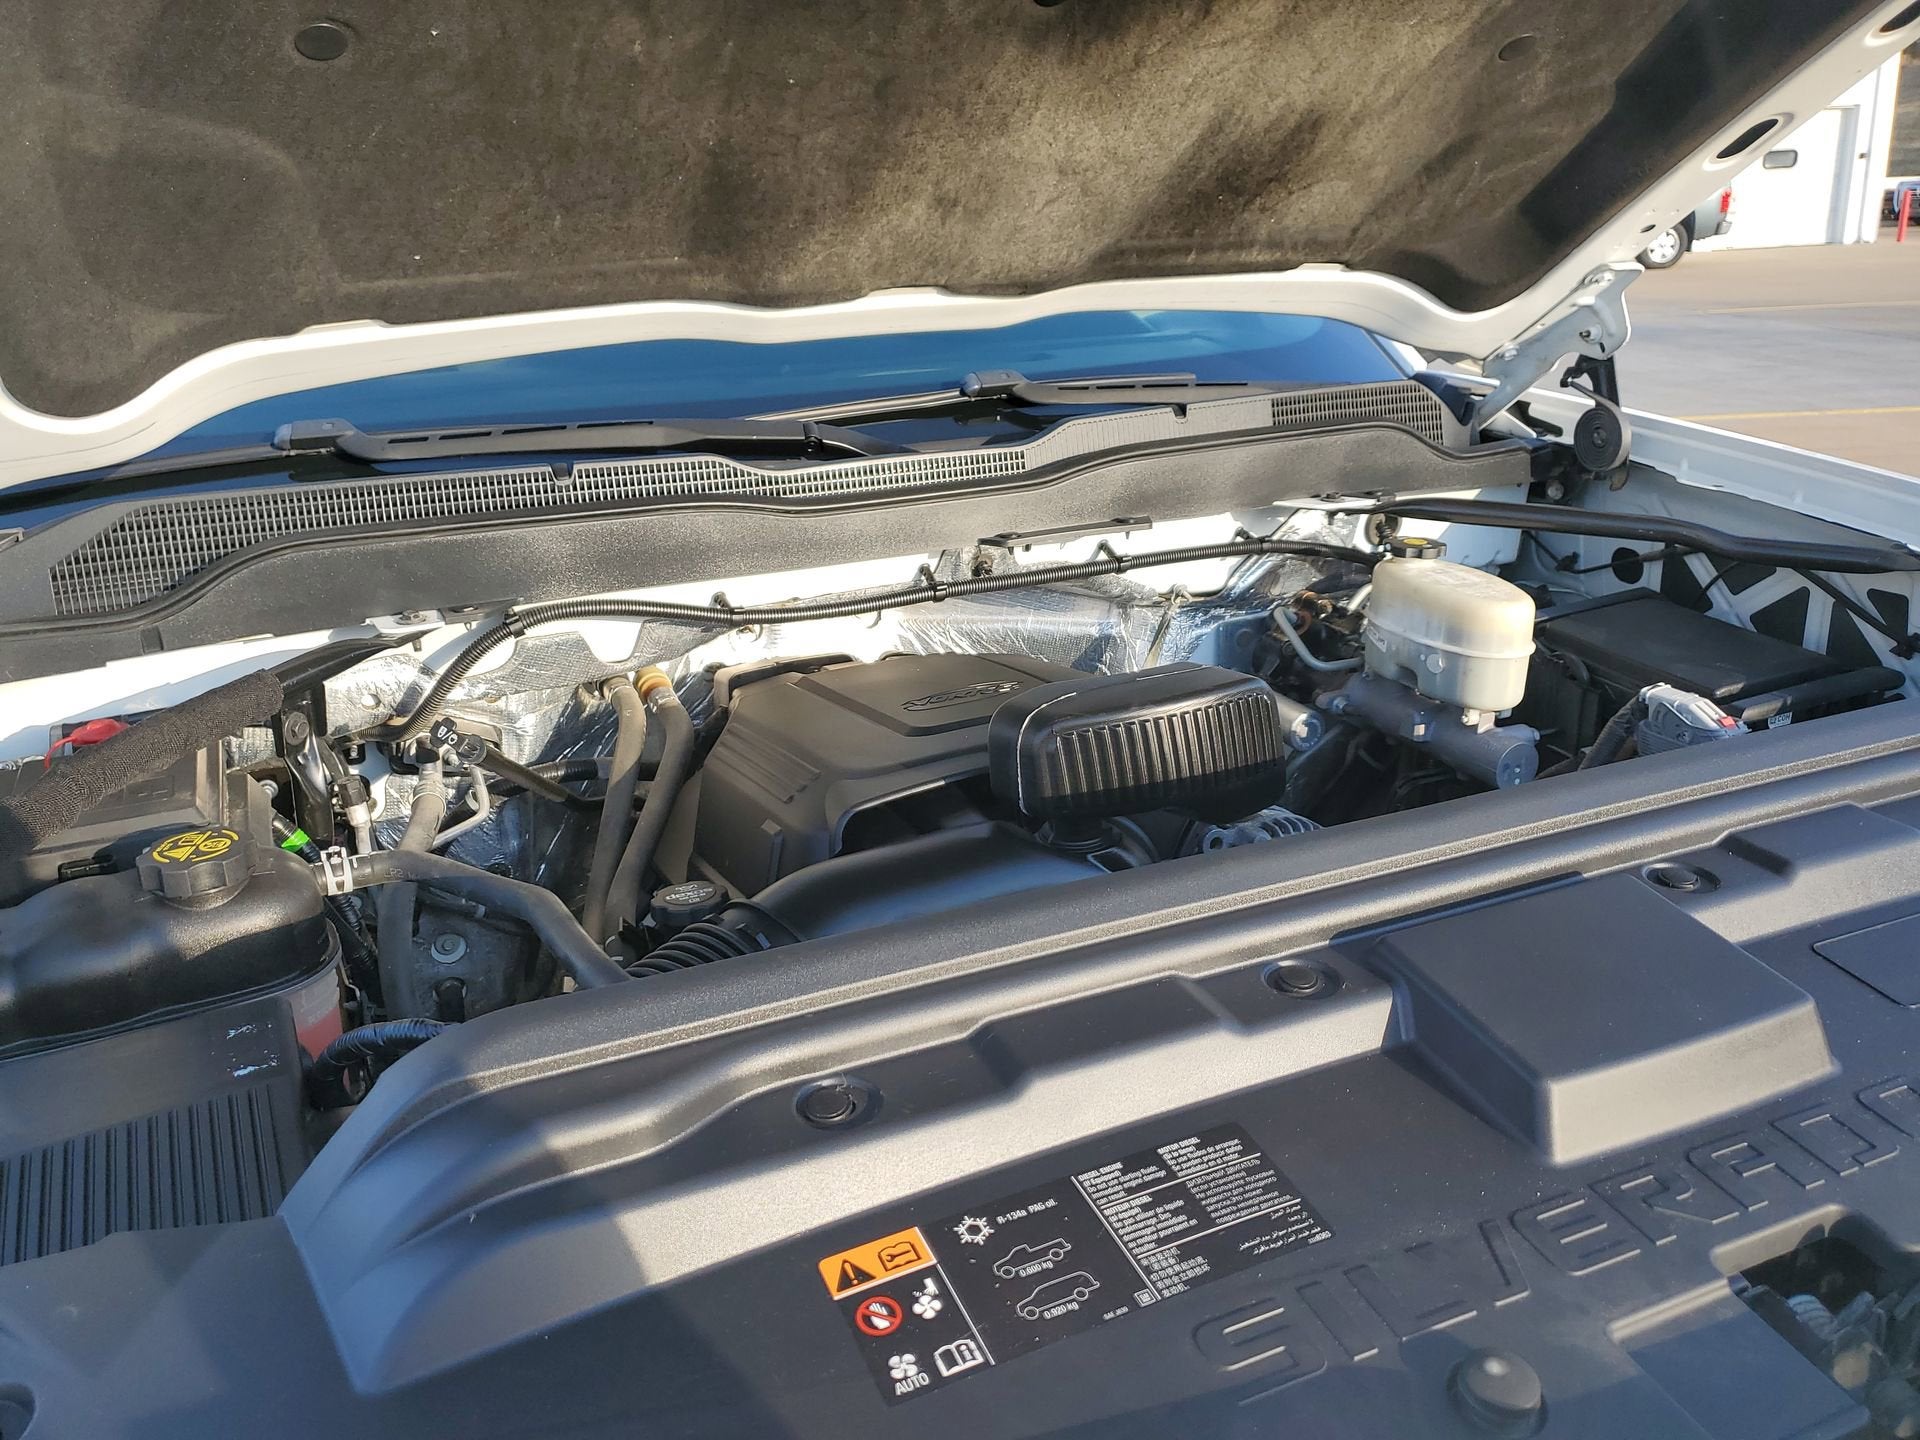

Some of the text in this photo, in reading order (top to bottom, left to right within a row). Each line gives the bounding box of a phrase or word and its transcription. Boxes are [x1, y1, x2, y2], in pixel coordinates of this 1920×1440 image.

[1078, 1170, 1101, 1181] DIESEL
[1118, 1171, 1142, 1183] starting
[1123, 1178, 1143, 1188] engine
[1143, 1170, 1167, 1182] damage
[997, 1208, 1027, 1225] R-134a
[1029, 1202, 1045, 1214] PAG
[1103, 1195, 1153, 1216] MOTEUR DIESEL
[1019, 1259, 1053, 1277] 0.600 kg
[1043, 1300, 1079, 1320] 0.920 kg
[895, 1372, 929, 1397] AUTO
